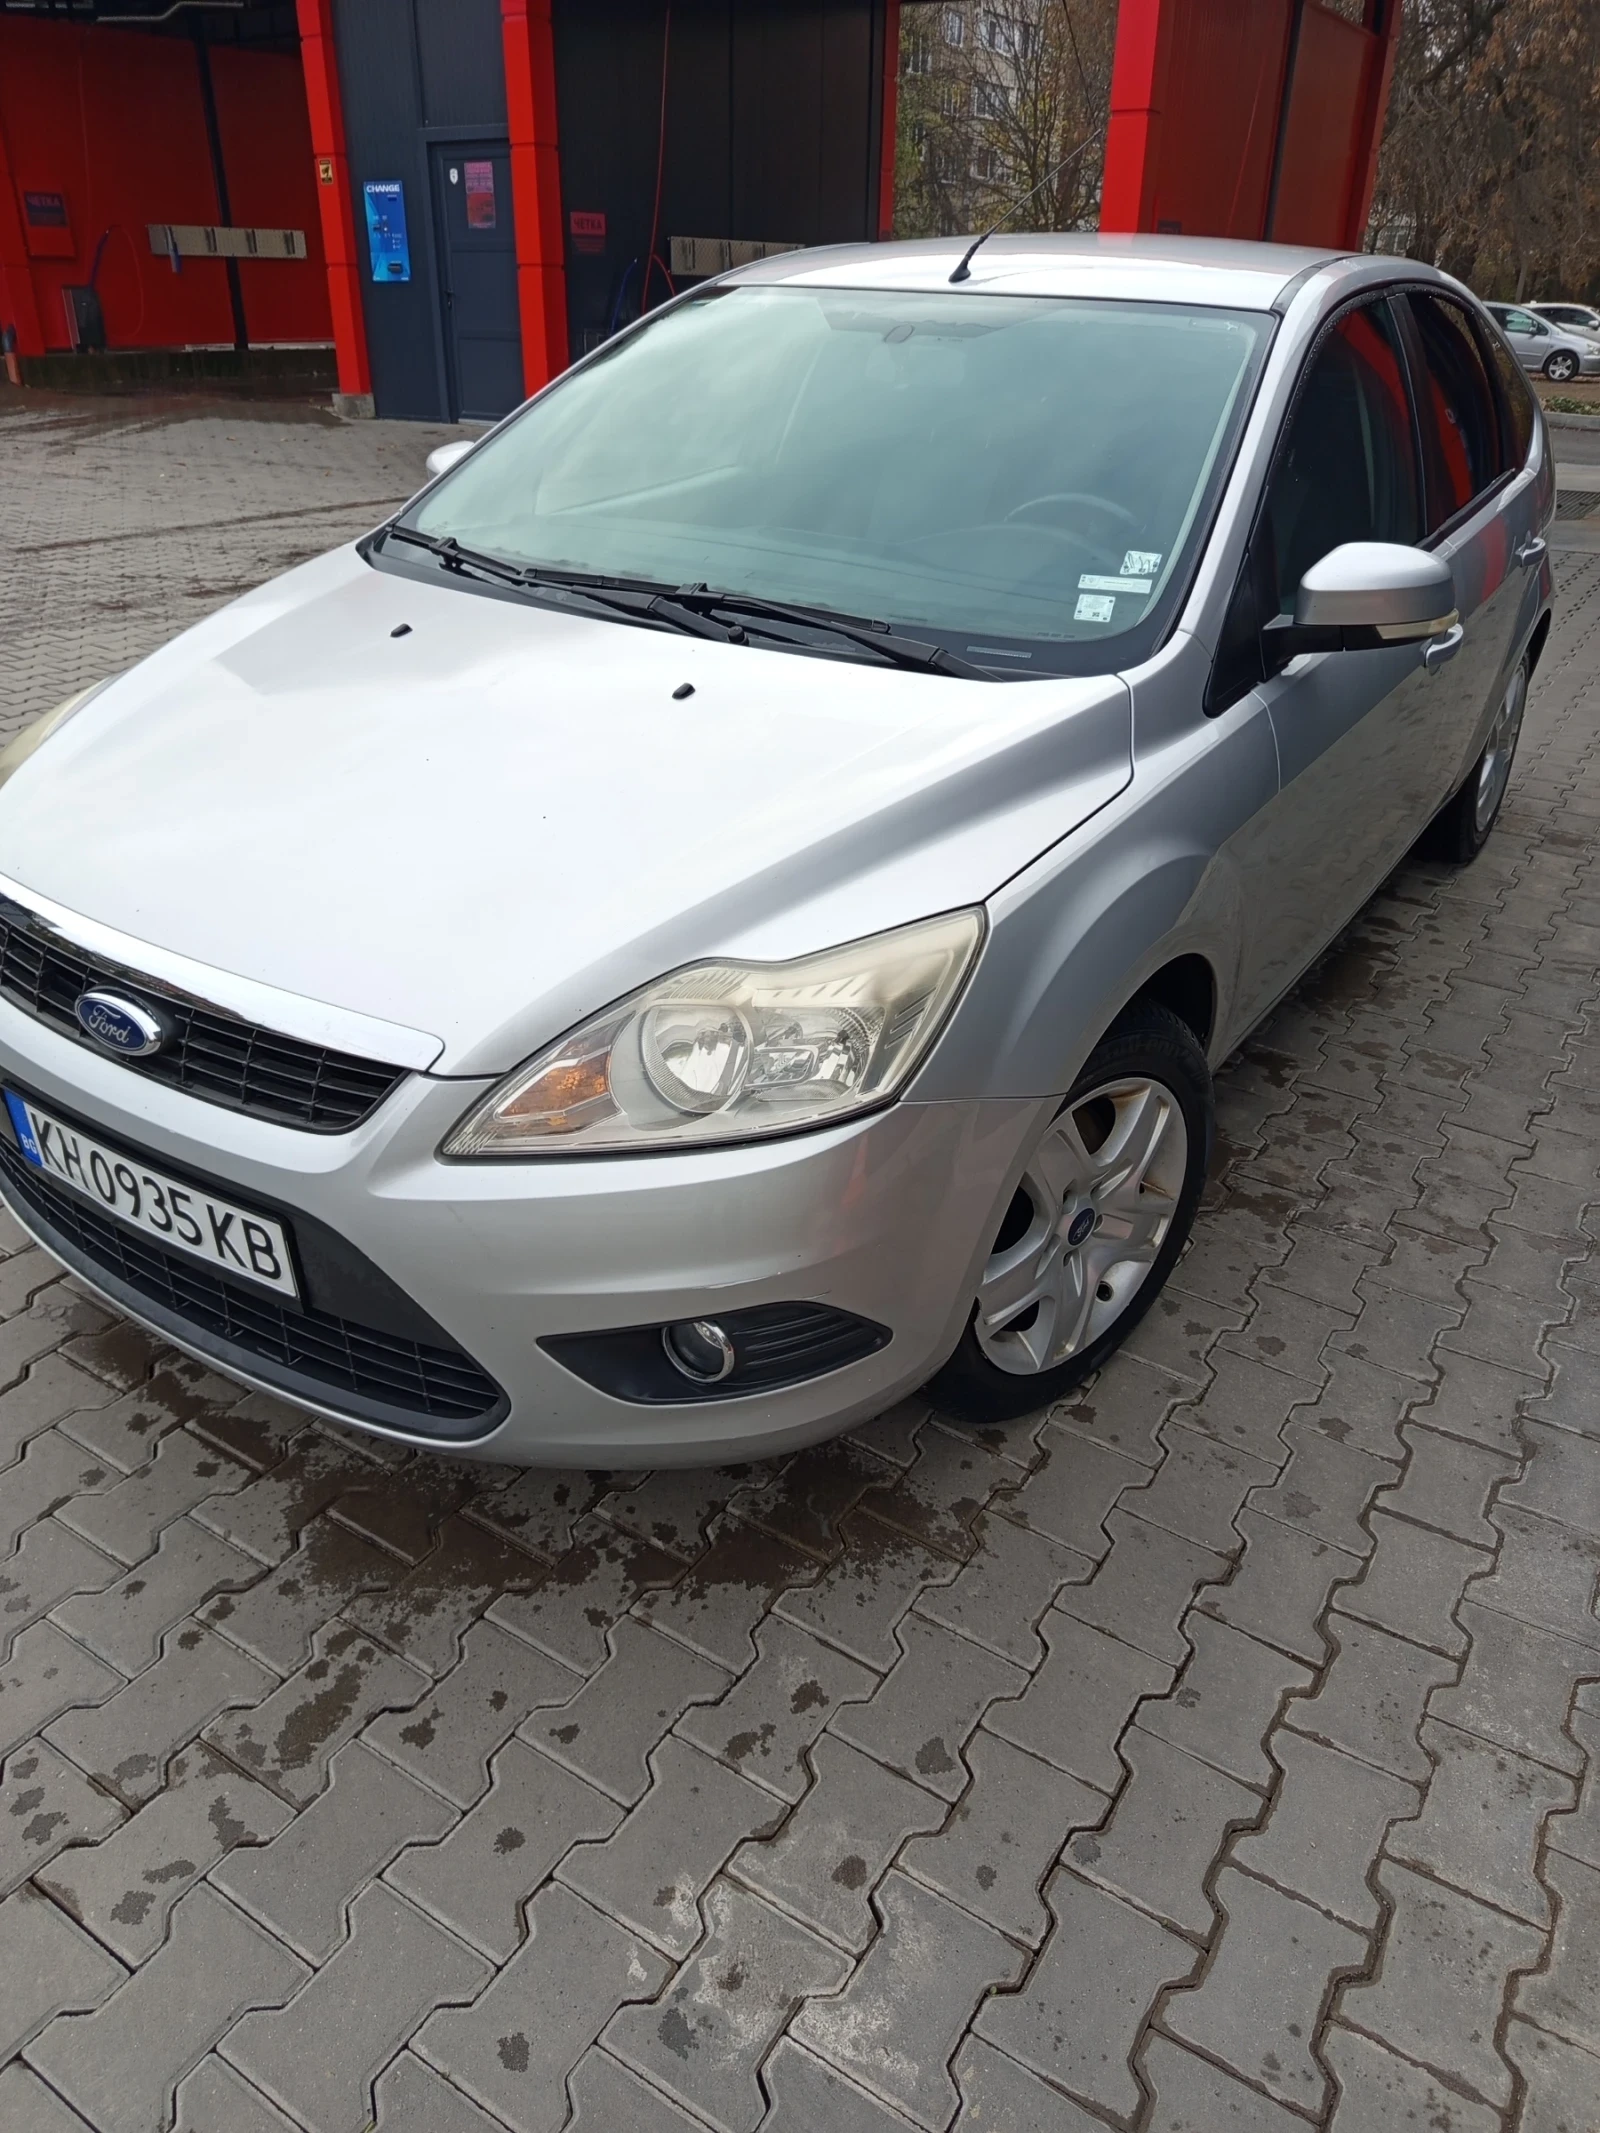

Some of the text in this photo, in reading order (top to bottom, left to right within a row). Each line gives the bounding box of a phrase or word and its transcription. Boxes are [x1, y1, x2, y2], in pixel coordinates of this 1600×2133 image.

[366, 184, 400, 193] CHANGE
[573, 216, 603, 230] ЧЕТКА
[88, 1004, 131, 1043] Ford
[21, 1132, 38, 1155] BG
